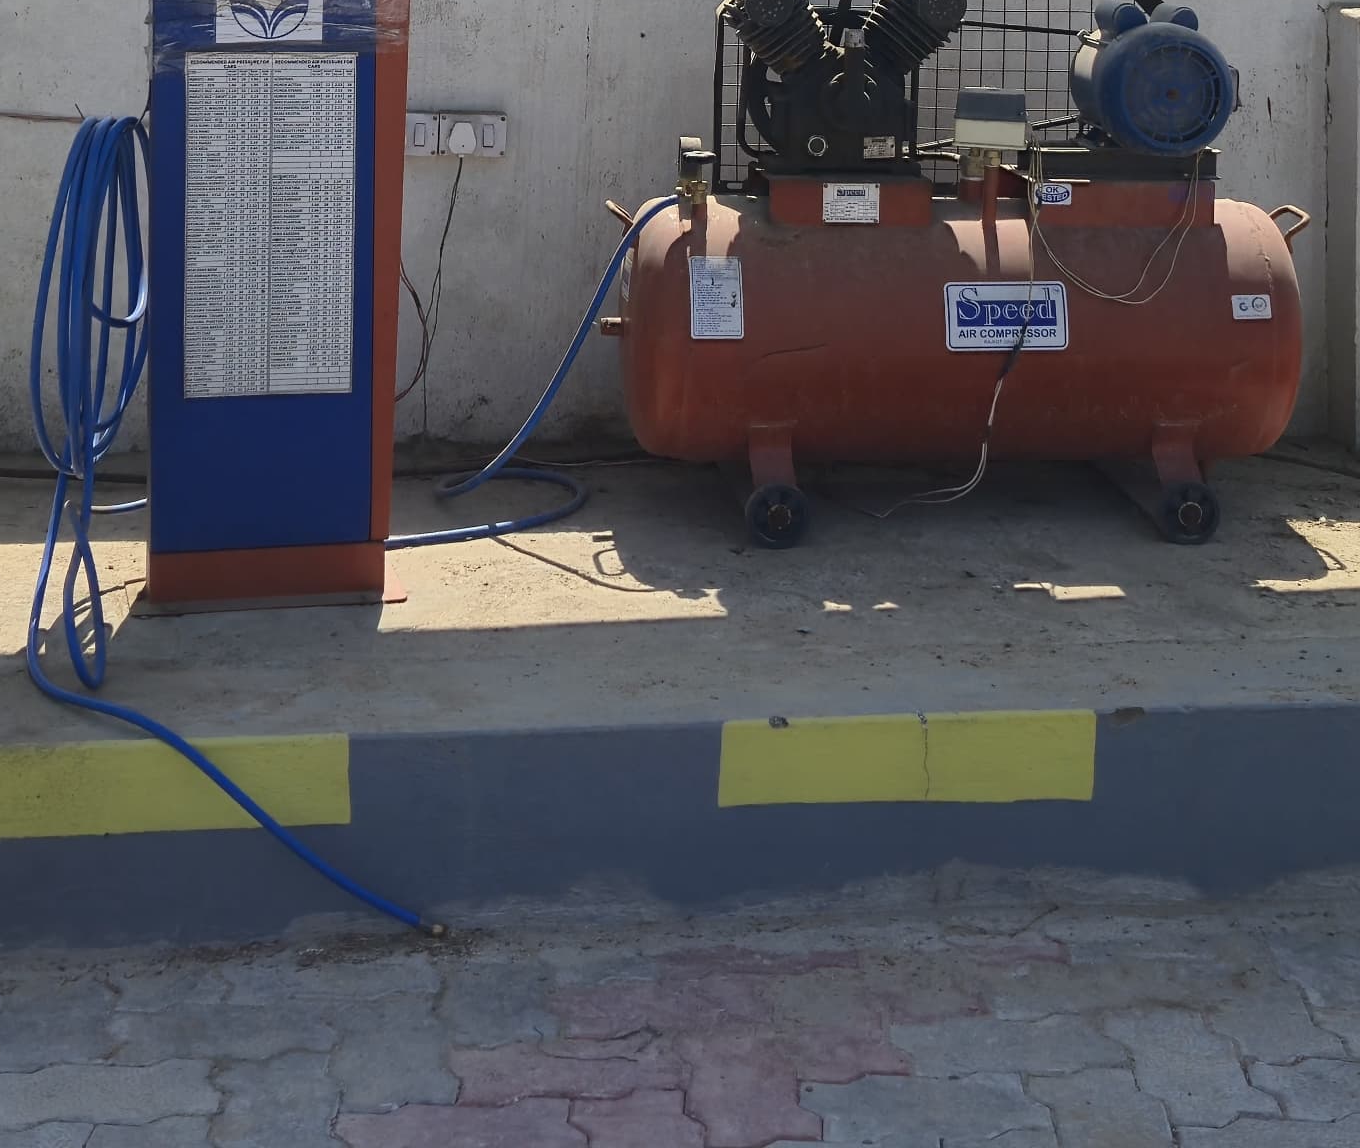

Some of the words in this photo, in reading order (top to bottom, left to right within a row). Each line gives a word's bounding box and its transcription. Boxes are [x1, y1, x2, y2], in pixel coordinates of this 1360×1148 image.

[1037, 192, 1069, 202] ESTED
[958, 287, 1056, 326] Speed
[958, 330, 977, 339] AIR
